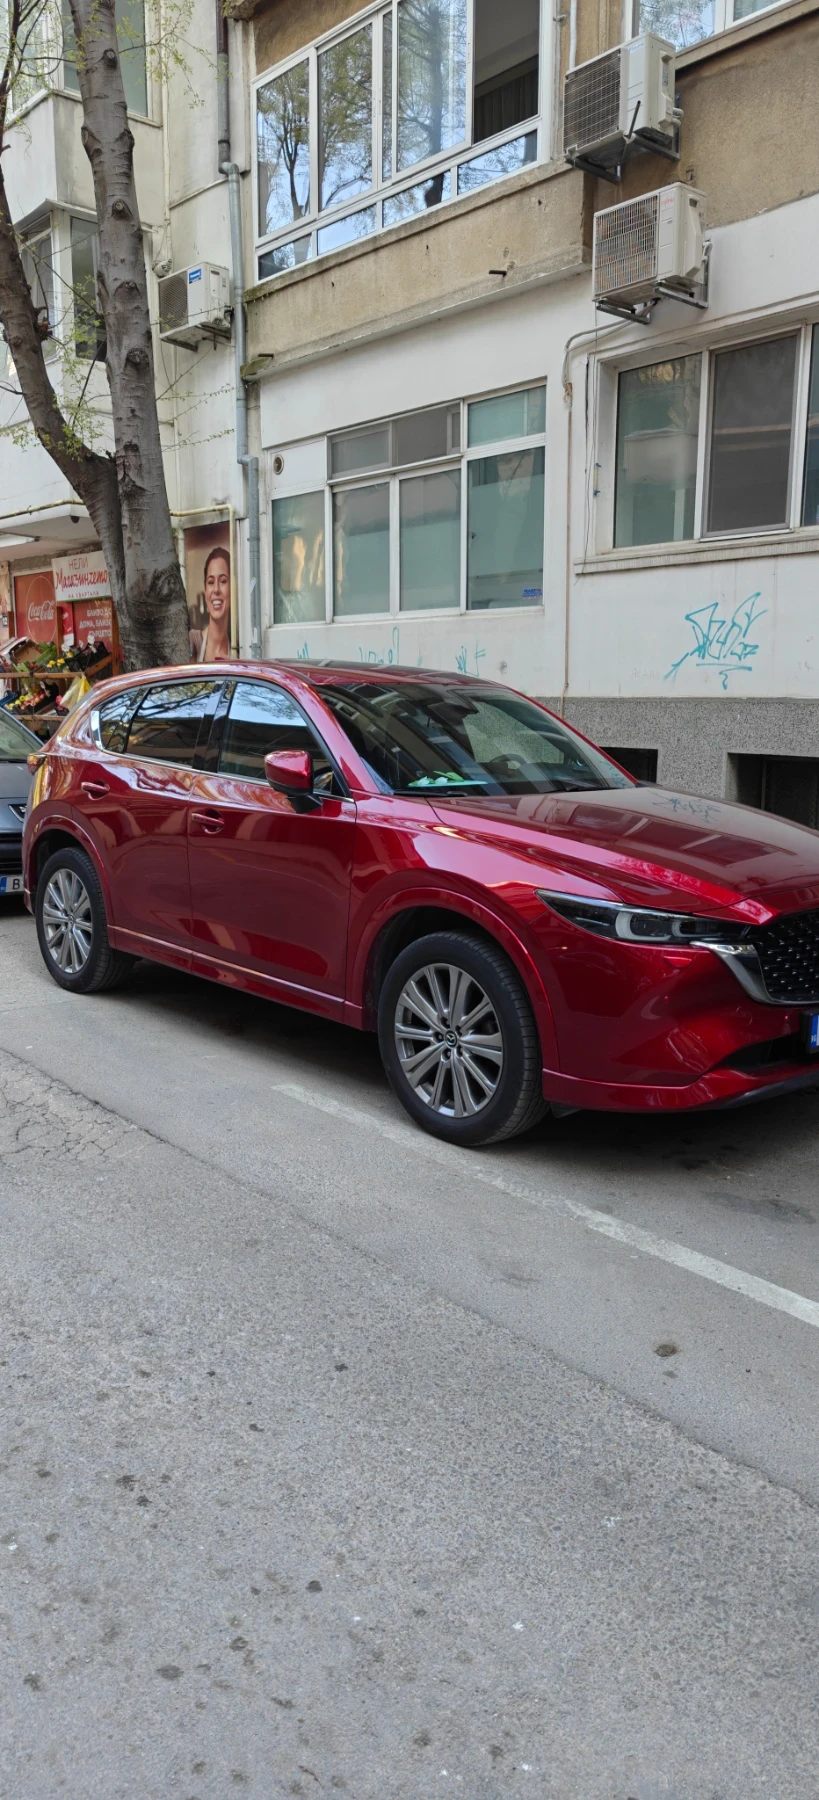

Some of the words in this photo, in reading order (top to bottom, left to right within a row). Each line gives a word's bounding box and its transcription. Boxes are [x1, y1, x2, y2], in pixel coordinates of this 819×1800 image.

[68, 557, 88, 570] НЕЛИ
[56, 568, 108, 592] Магазинчето
[87, 608, 103, 617] БЛИЗО
[79, 620, 95, 629] ДОМА,
